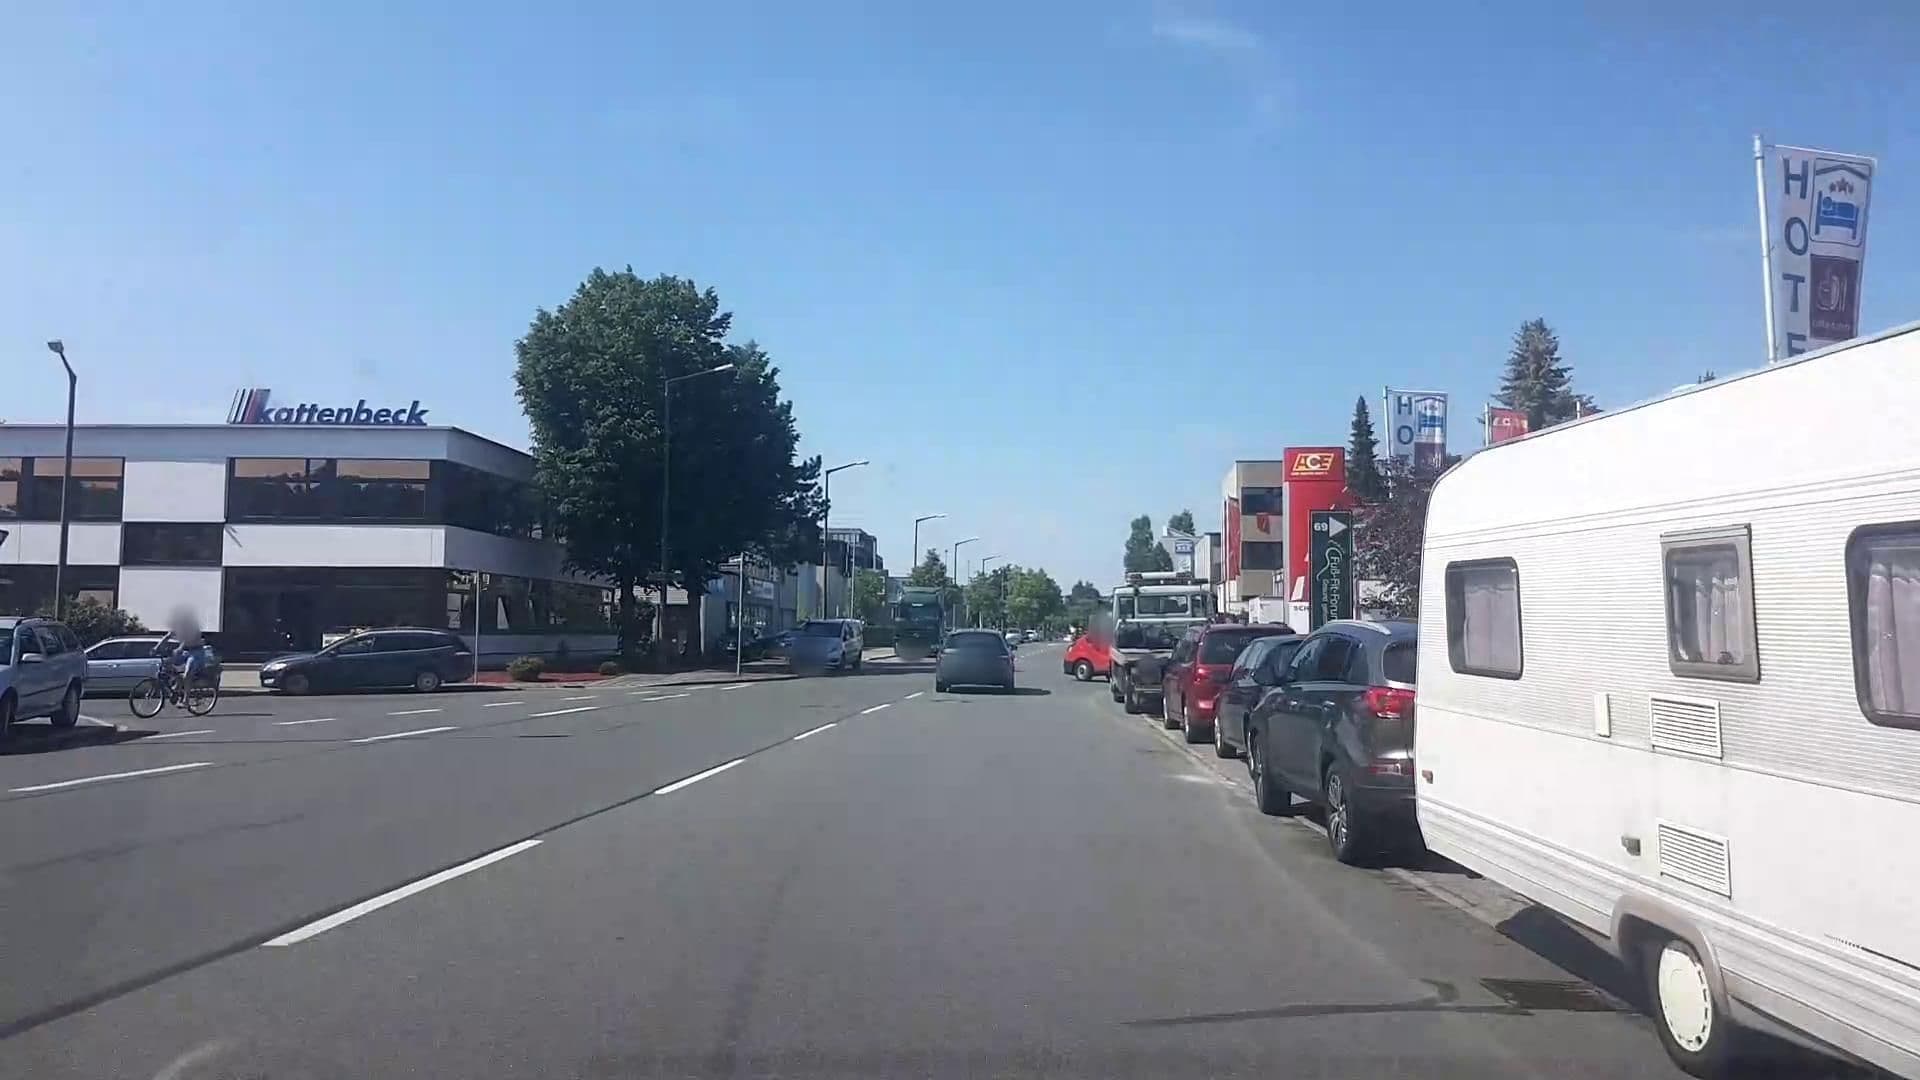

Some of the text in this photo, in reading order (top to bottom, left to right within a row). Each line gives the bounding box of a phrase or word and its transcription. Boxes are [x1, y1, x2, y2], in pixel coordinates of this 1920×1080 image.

[248, 389, 430, 425] kattenbeck
[1294, 454, 1332, 470] ACE
[1314, 522, 1328, 532] 69
